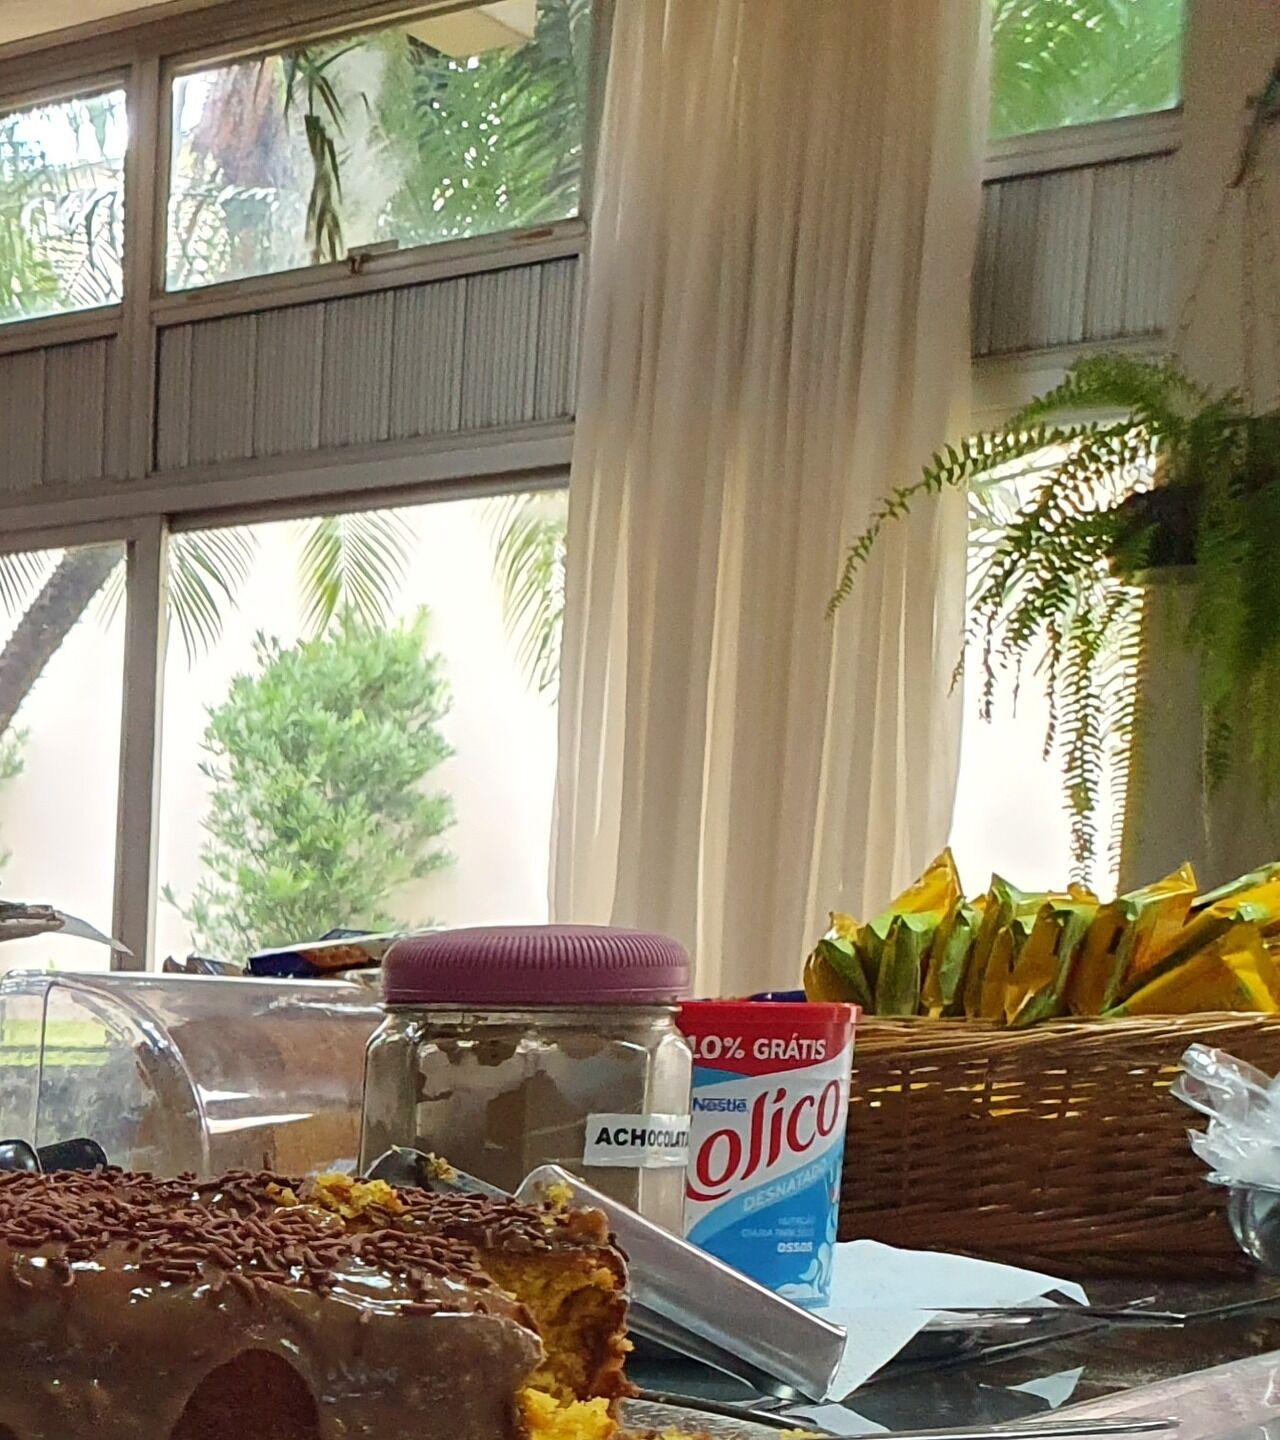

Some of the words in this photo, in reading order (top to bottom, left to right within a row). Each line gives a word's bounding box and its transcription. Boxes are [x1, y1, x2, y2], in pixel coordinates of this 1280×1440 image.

[753, 1033, 826, 1060] GRÁTIS
[692, 1096, 747, 1112] Nestlé
[687, 1080, 840, 1201] olico
